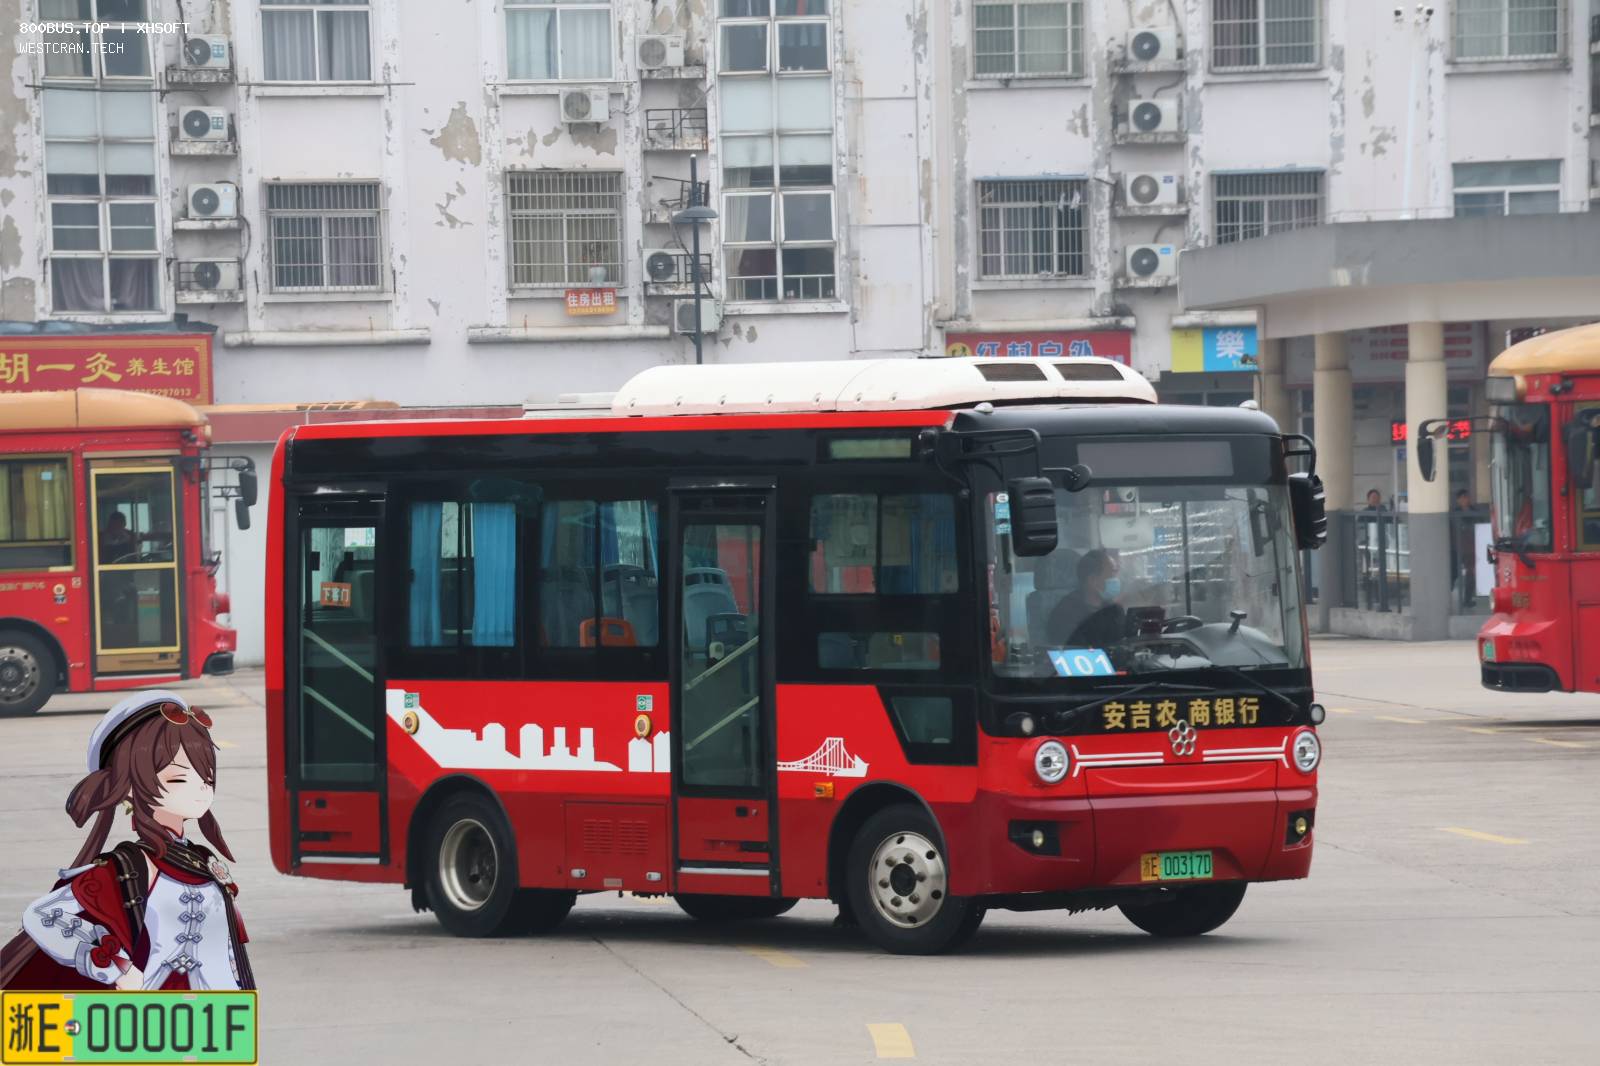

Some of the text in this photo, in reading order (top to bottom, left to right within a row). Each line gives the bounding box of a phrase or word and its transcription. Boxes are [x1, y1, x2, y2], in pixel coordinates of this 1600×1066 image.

[567, 291, 615, 307] 住房出租
[126, 357, 195, 376] 养生馆
[1055, 653, 1114, 676] 101
